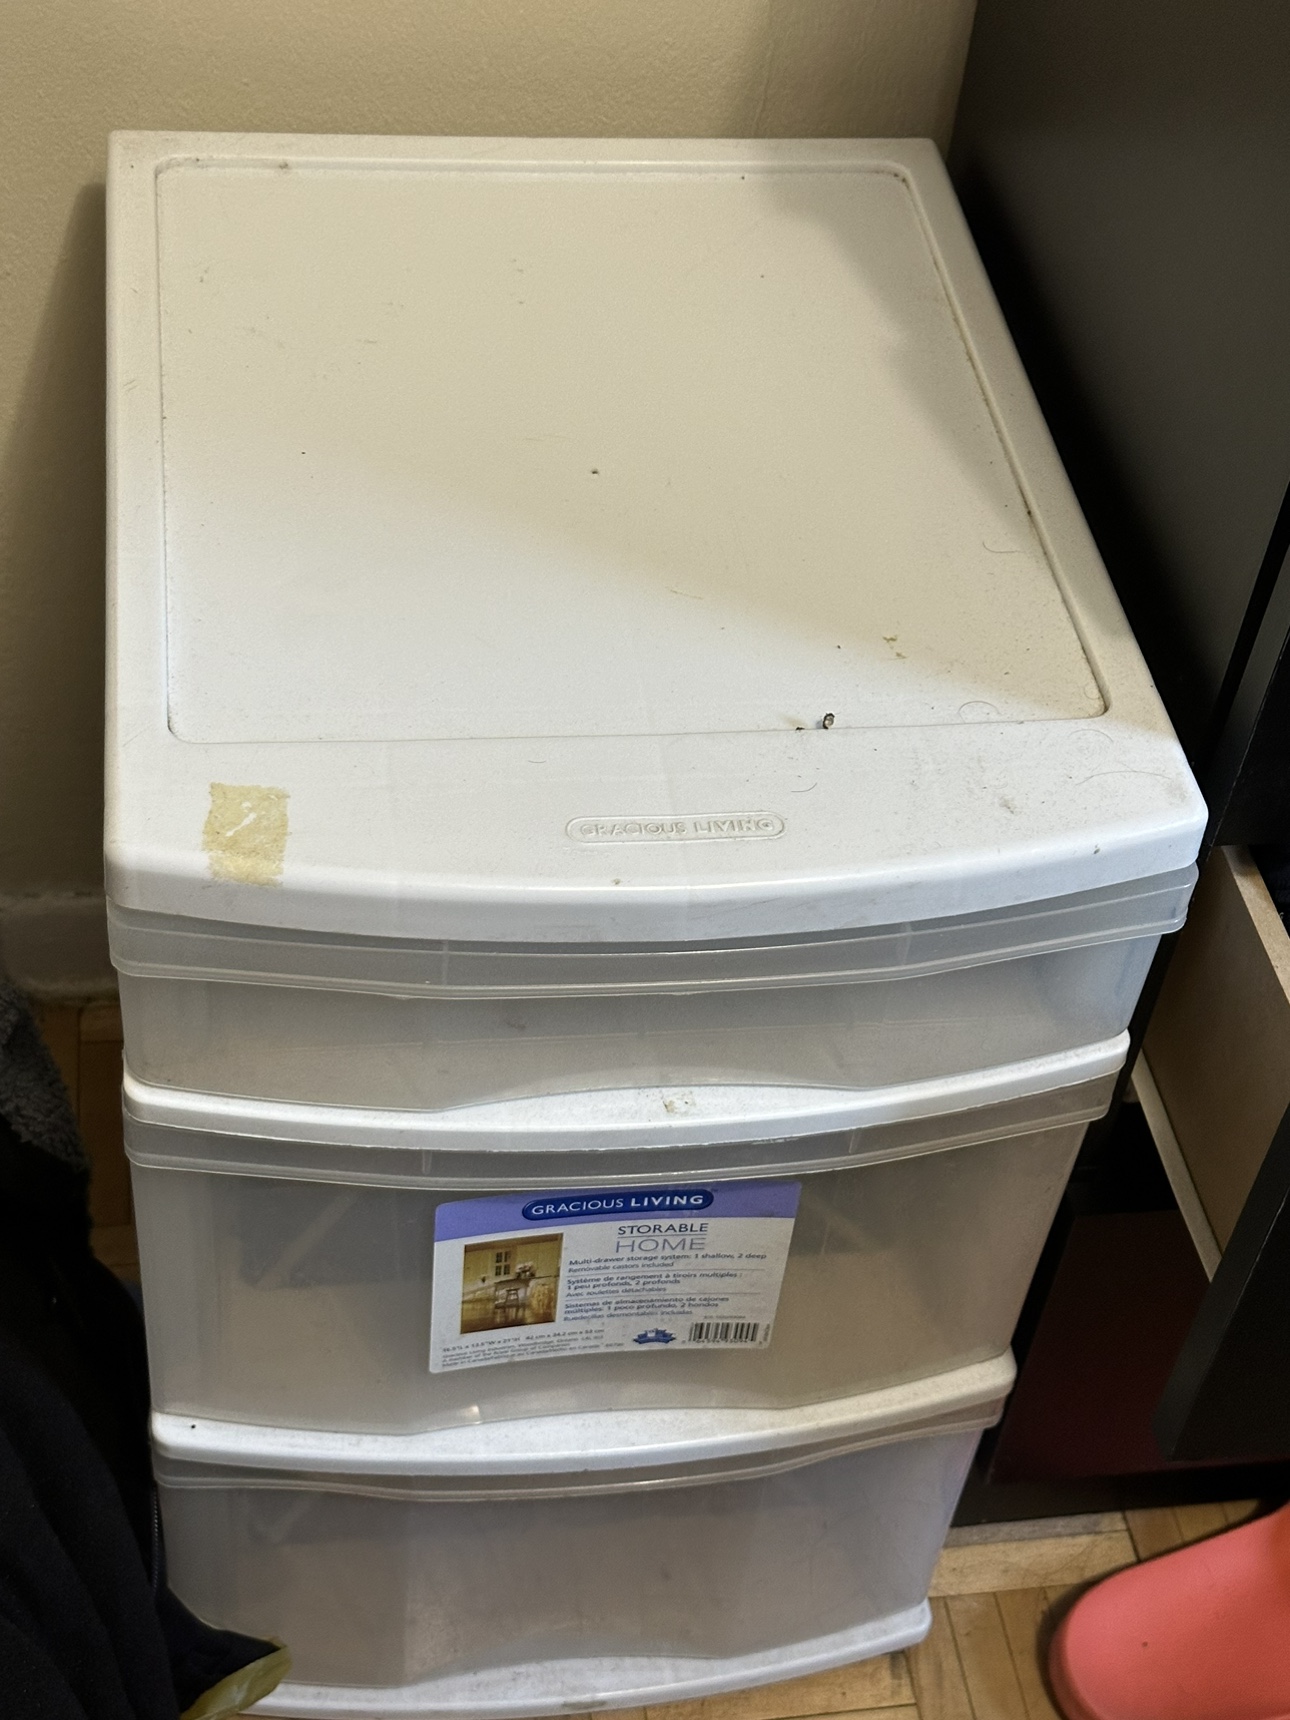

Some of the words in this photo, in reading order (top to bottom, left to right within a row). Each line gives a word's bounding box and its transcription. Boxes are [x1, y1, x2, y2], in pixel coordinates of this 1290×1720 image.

[580, 821, 686, 836] GRACIOUS
[694, 819, 773, 833] LIVING
[531, 1198, 624, 1215] GRACIOUS
[630, 1194, 703, 1207] LIVING
[617, 1222, 709, 1236] STORABLE
[615, 1237, 707, 1253] HOME
[569, 1256, 624, 1265] Multi-drawer
[745, 1252, 767, 1260] deep
[568, 1265, 611, 1273] Removable
[616, 1273, 663, 1281] rangement
[565, 1301, 600, 1309] Sistemas
